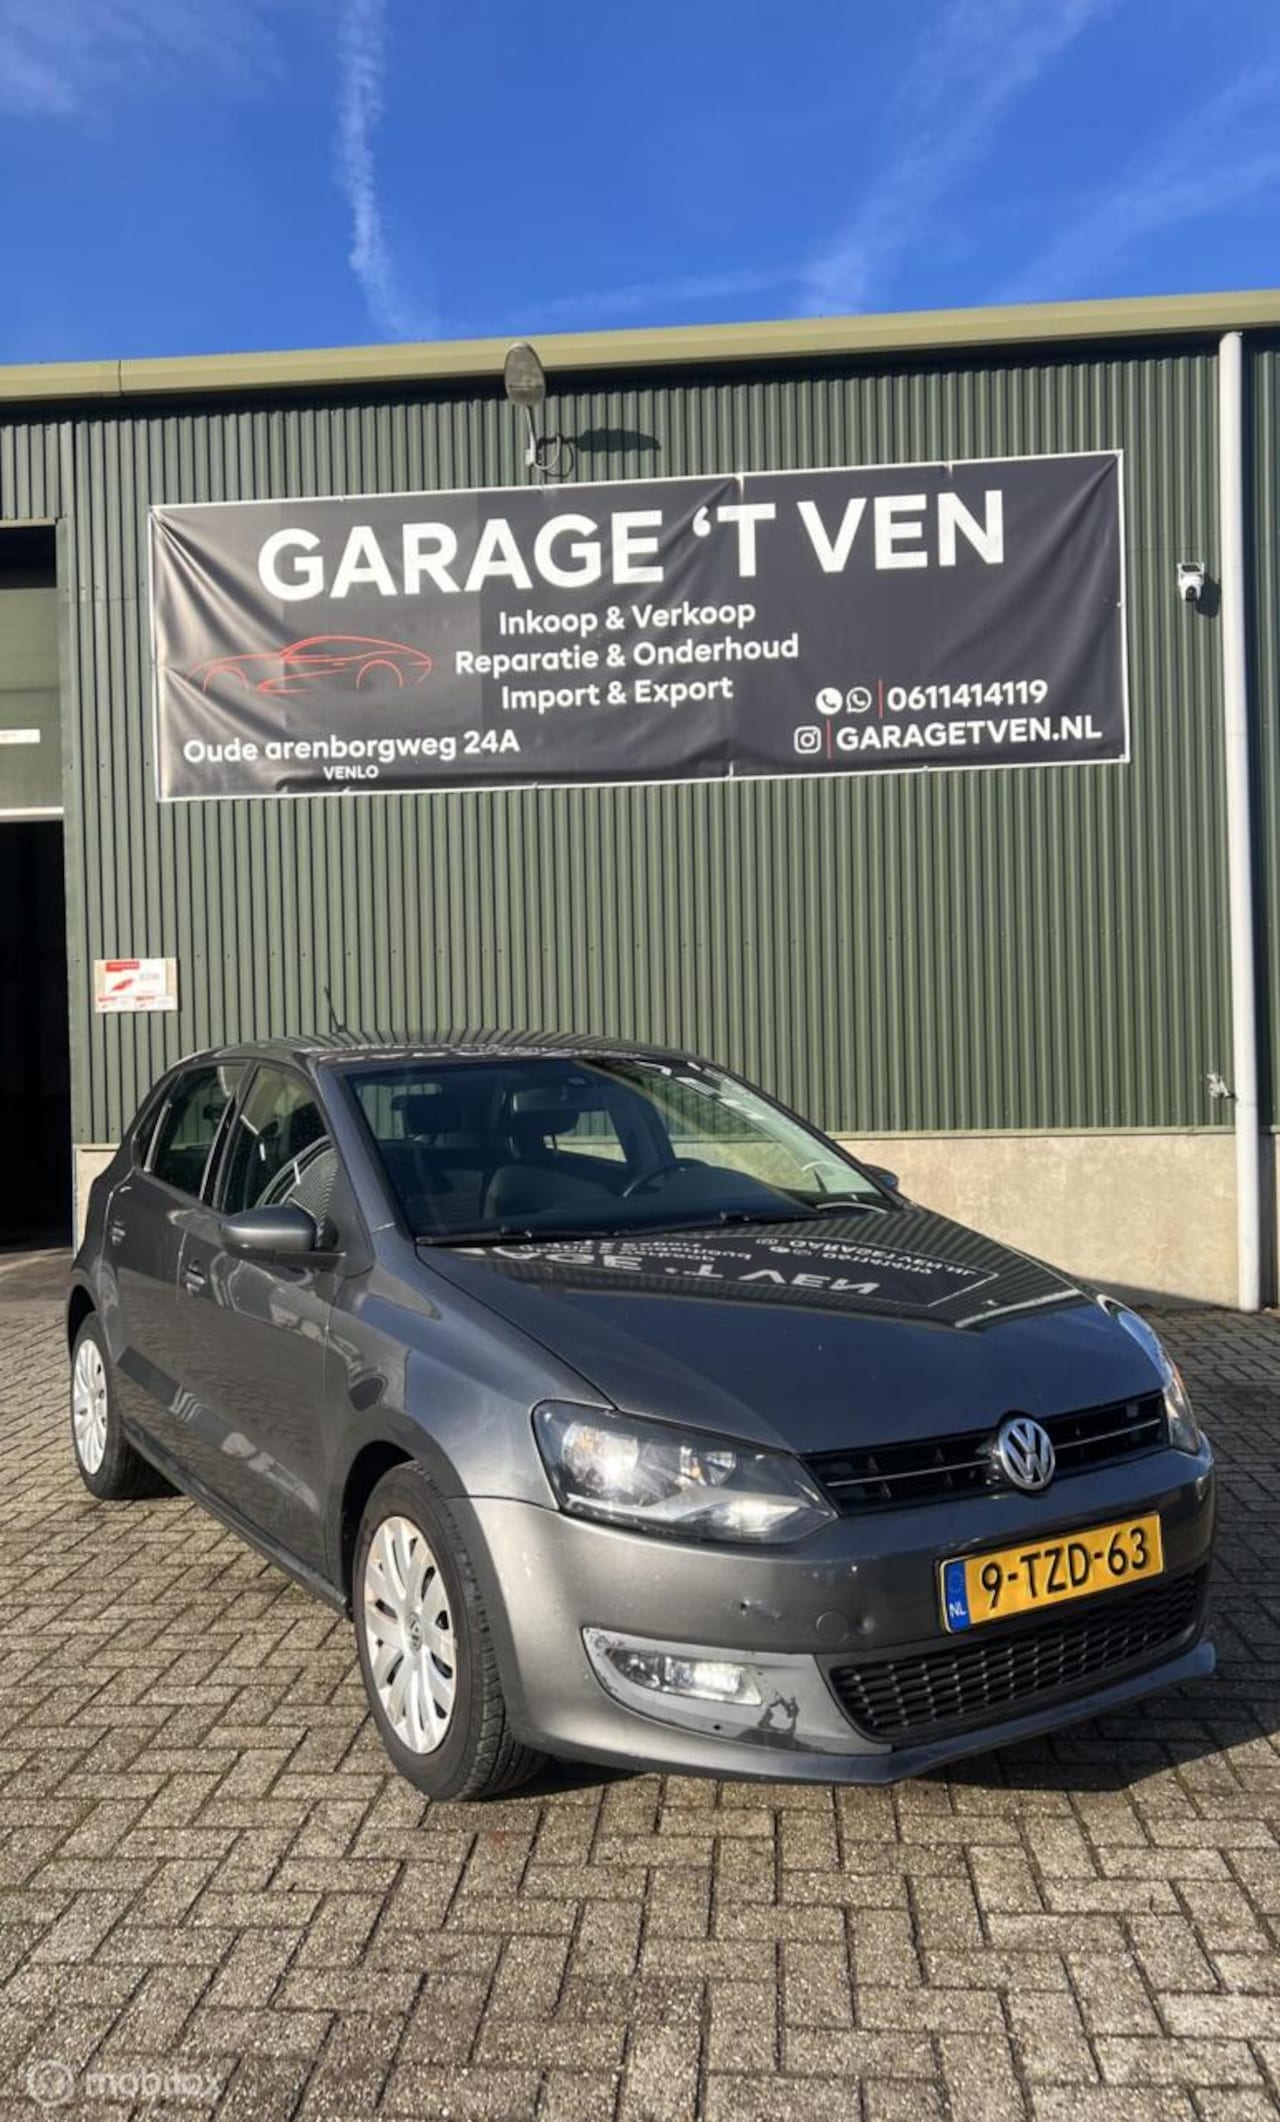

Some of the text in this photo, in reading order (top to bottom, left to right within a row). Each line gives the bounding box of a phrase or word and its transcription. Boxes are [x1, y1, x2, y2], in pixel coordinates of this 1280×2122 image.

[257, 509, 665, 601] GARAGE
[796, 490, 1004, 573] VEN
[499, 601, 756, 639] Inkoop & Verkoop
[455, 633, 799, 680] Reparatie & Onderhoud
[501, 677, 734, 715] Import & Export
[886, 680, 1049, 712] 0611414119
[183, 729, 521, 764] Oude arenborgweg 24A
[836, 715, 1103, 751] GARAGETVEN.NL
[322, 765, 379, 781] VENLO
[980, 1527, 1149, 1611] 9-TZD-63
[949, 1602, 967, 1618] NL
